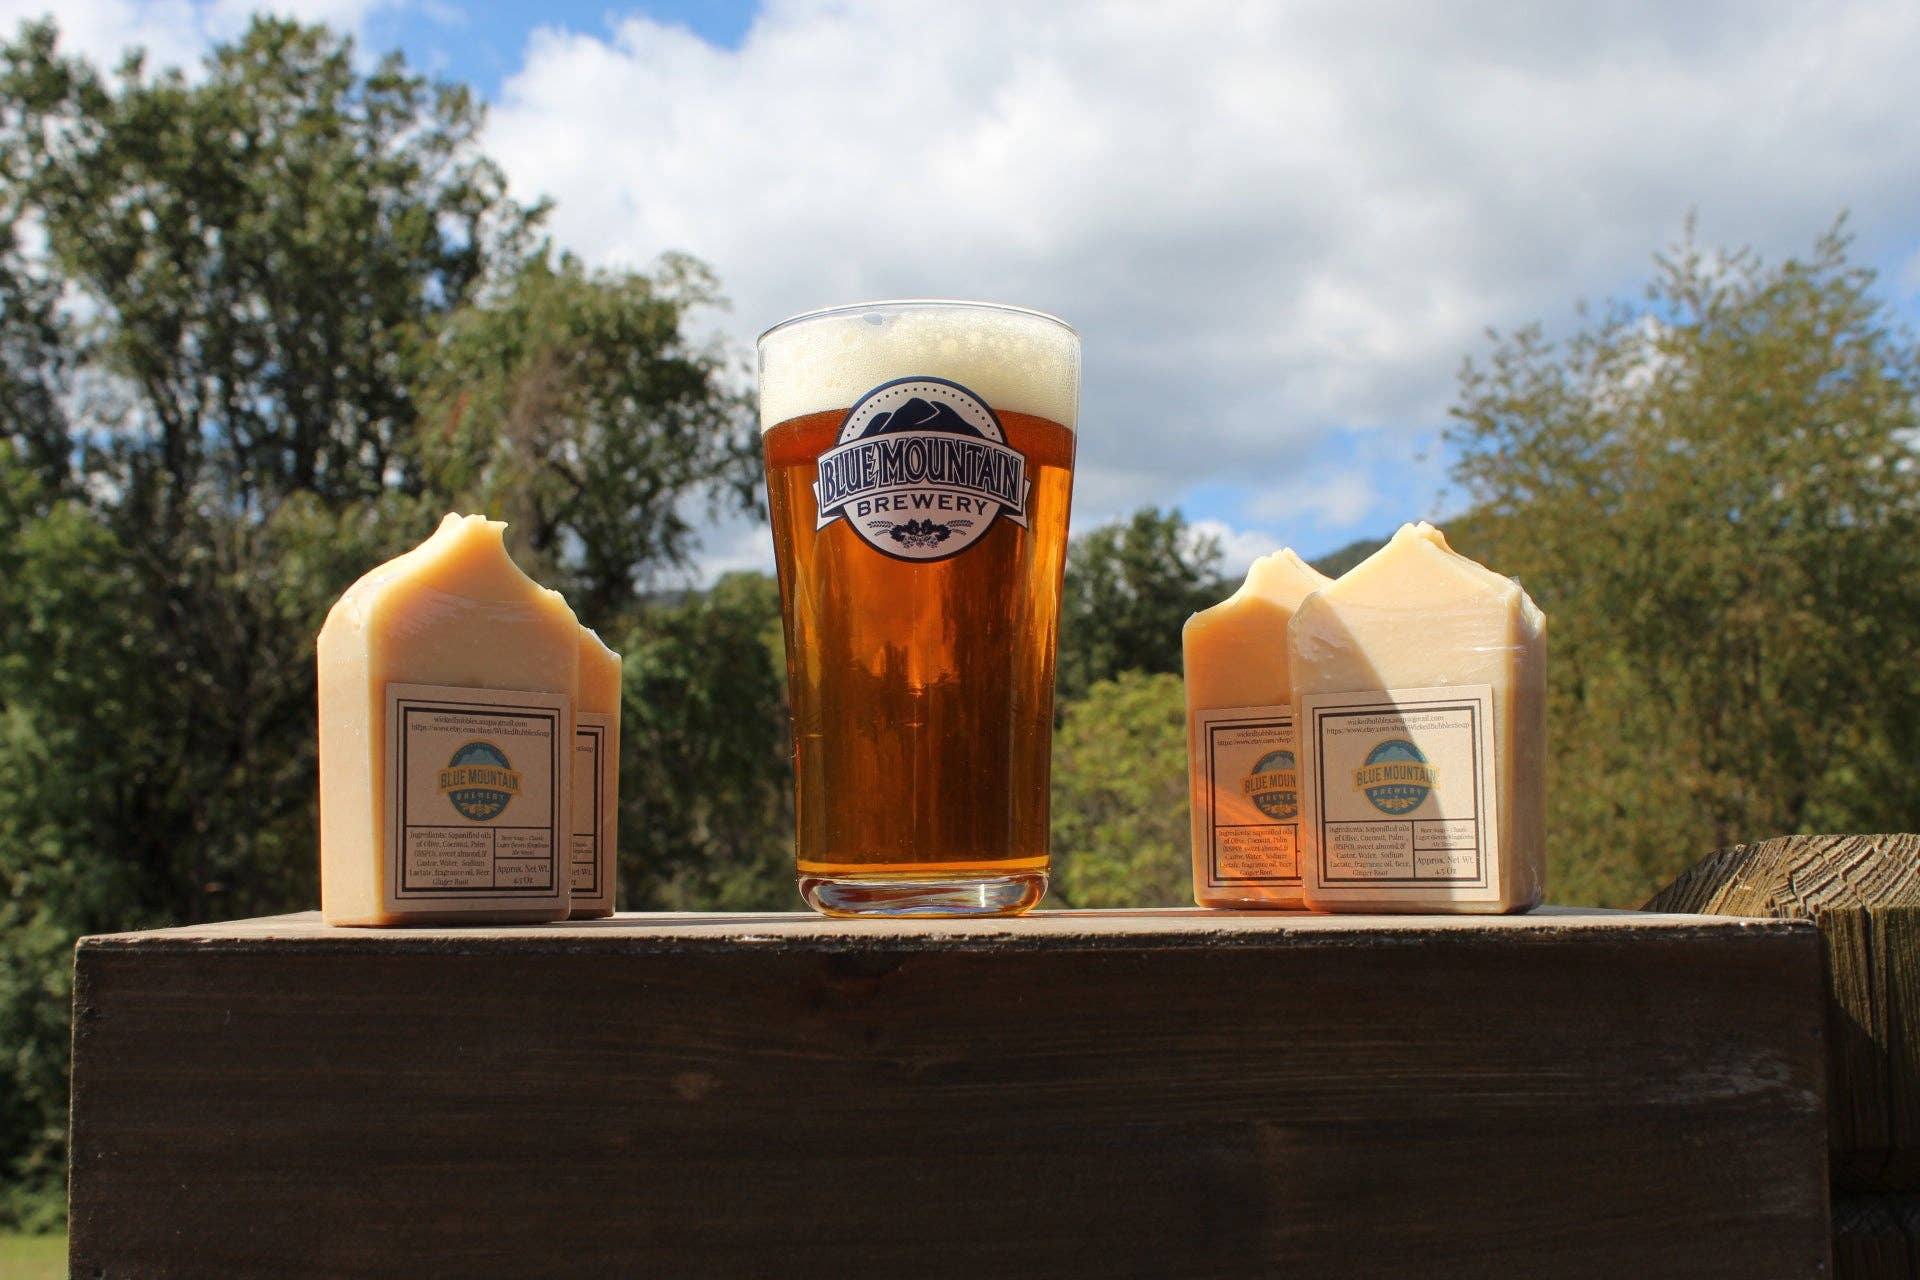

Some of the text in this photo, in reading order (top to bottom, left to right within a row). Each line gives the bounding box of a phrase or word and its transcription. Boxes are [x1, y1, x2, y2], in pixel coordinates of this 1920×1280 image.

[821, 436, 1021, 508] BLUE MOUNTAIN
[856, 494, 989, 518] BREWERY
[441, 769, 519, 790] BLUE MOUNTAIN
[1357, 765, 1437, 786] BLUE MOUNTAIN
[1245, 778, 1267, 795] BLUE
[497, 865, 521, 875] Approx.
[525, 864, 537, 874] Net
[1417, 857, 1444, 867] Approx.
